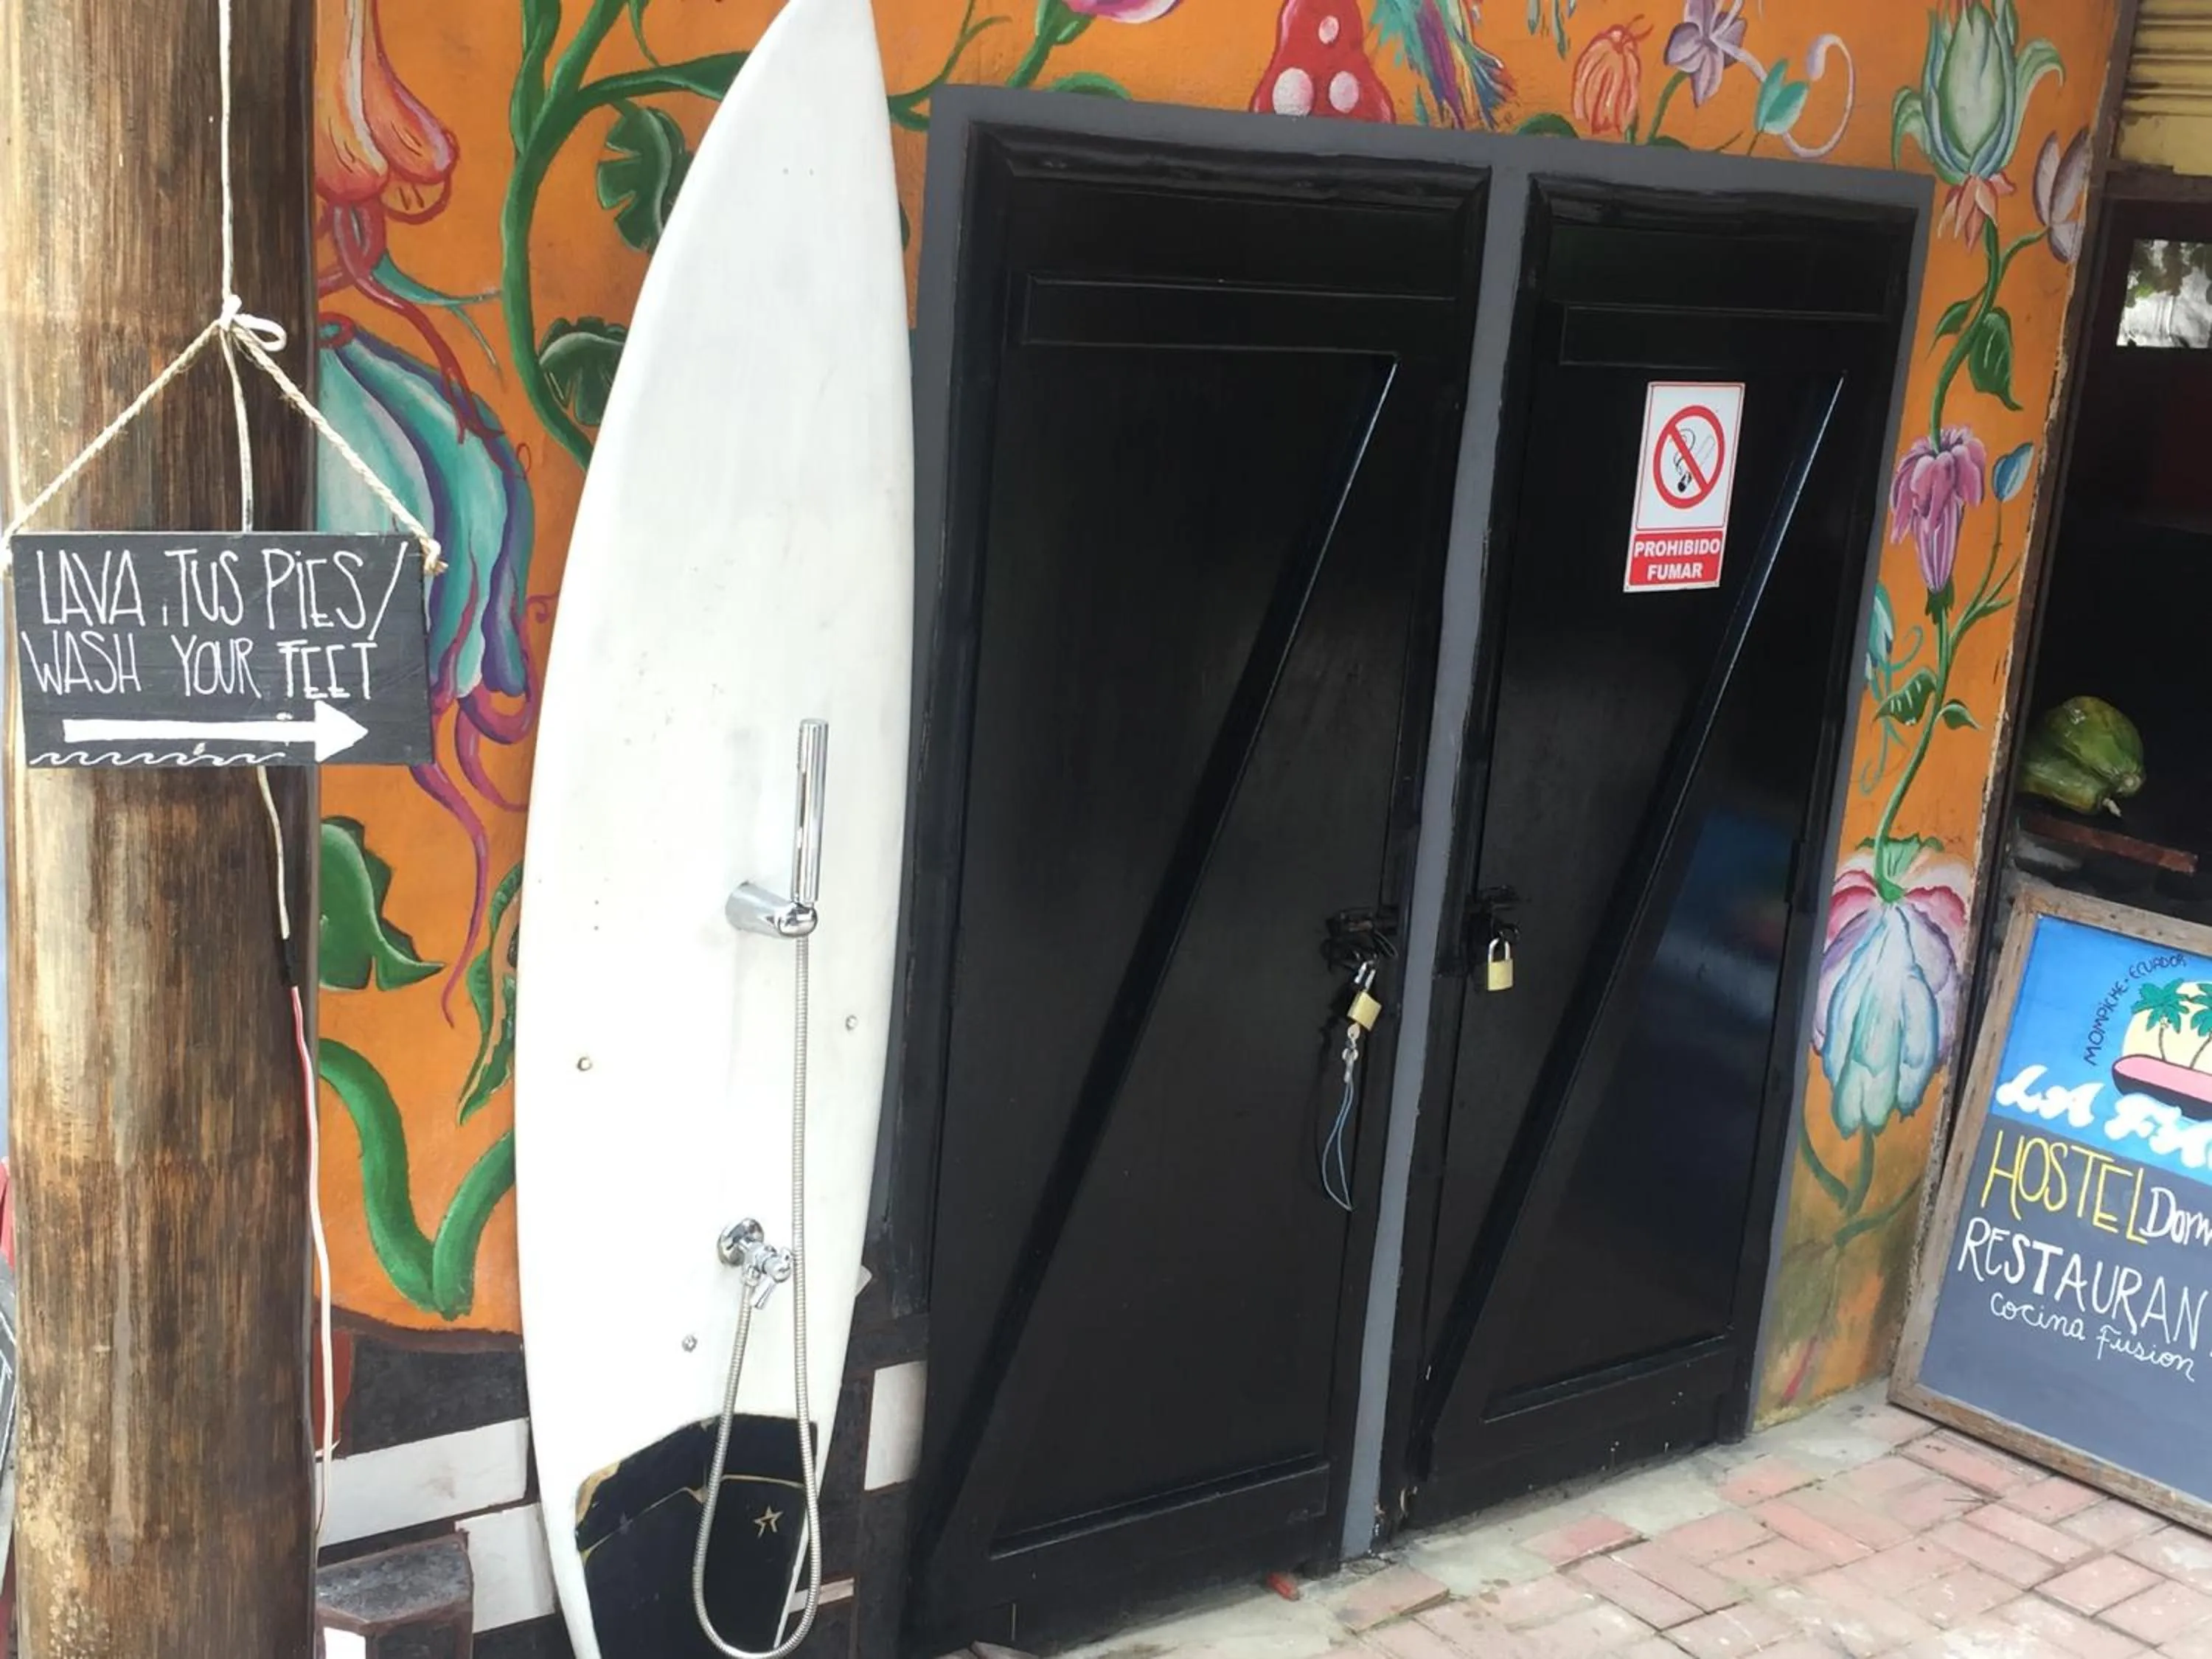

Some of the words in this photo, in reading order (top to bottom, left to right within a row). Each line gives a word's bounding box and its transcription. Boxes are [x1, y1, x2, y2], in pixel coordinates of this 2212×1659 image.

[1634, 539, 1720, 557] PROHIBIDO
[1647, 563, 1703, 580] FUMAR
[37, 549, 146, 626] LAVA
[21, 630, 142, 695] WASH
[170, 634, 262, 698] YOUR
[2129, 953, 2188, 979] ECUADOR
[1980, 1130, 2149, 1245] HOSTEL
[1958, 1217, 2212, 1357] RESTAURAN
